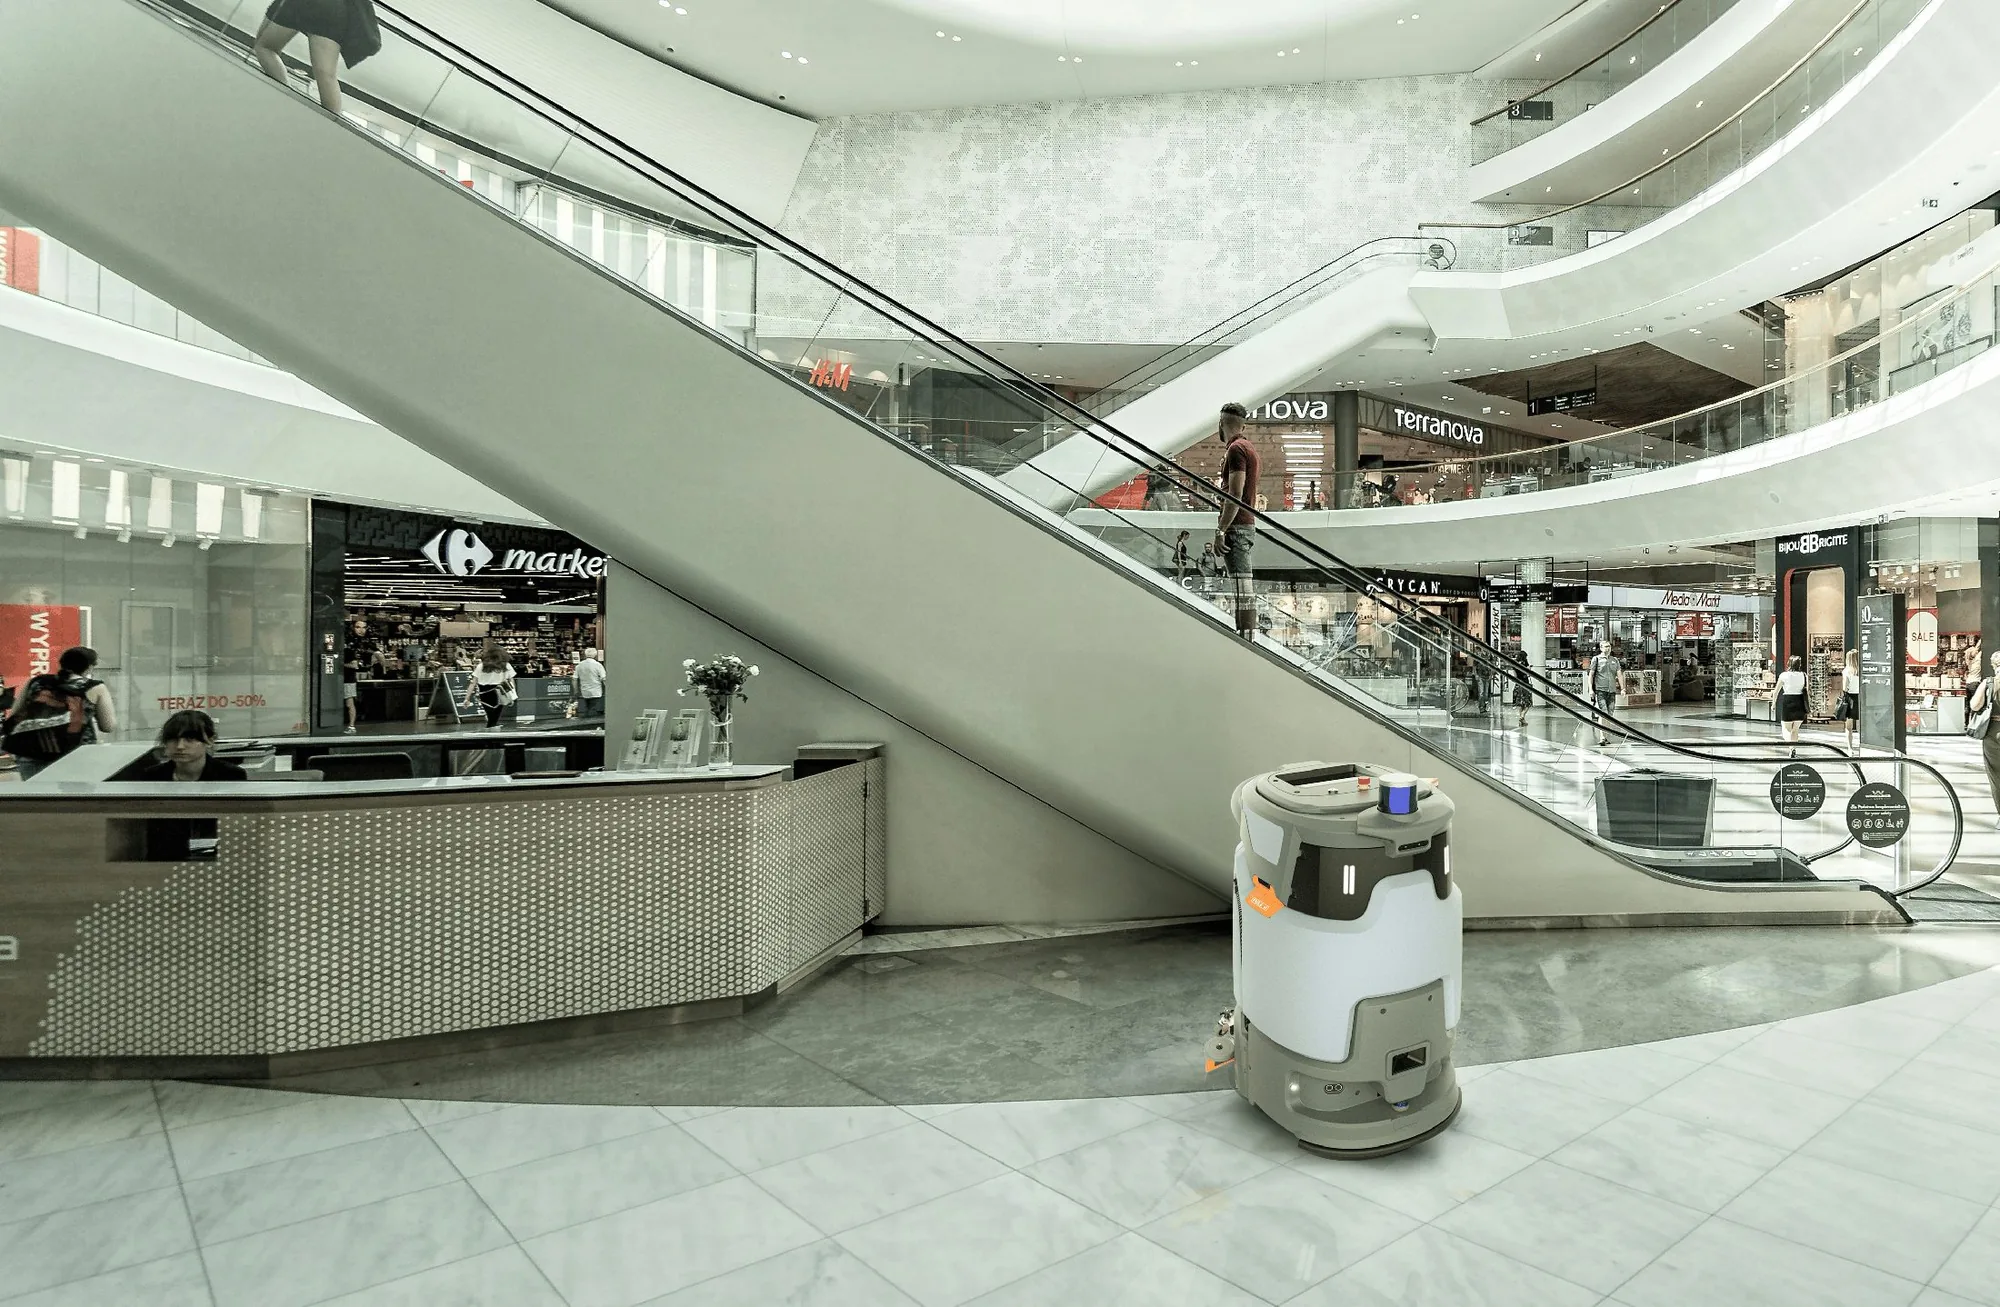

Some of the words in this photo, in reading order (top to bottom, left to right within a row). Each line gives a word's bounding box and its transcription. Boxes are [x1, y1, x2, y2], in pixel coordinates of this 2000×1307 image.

[1511, 103, 1520, 116] 3
[808, 358, 853, 392] H&M
[1245, 401, 1328, 420] nova
[1529, 402, 1535, 413] 1
[1480, 587, 1488, 601] 0
[1661, 589, 1690, 607] Media
[1696, 591, 1721, 608] Markt
[1911, 632, 1935, 642] SALE
[157, 696, 205, 710] TERAZ
[207, 696, 229, 708] DO
[230, 694, 266, 708] -50%
